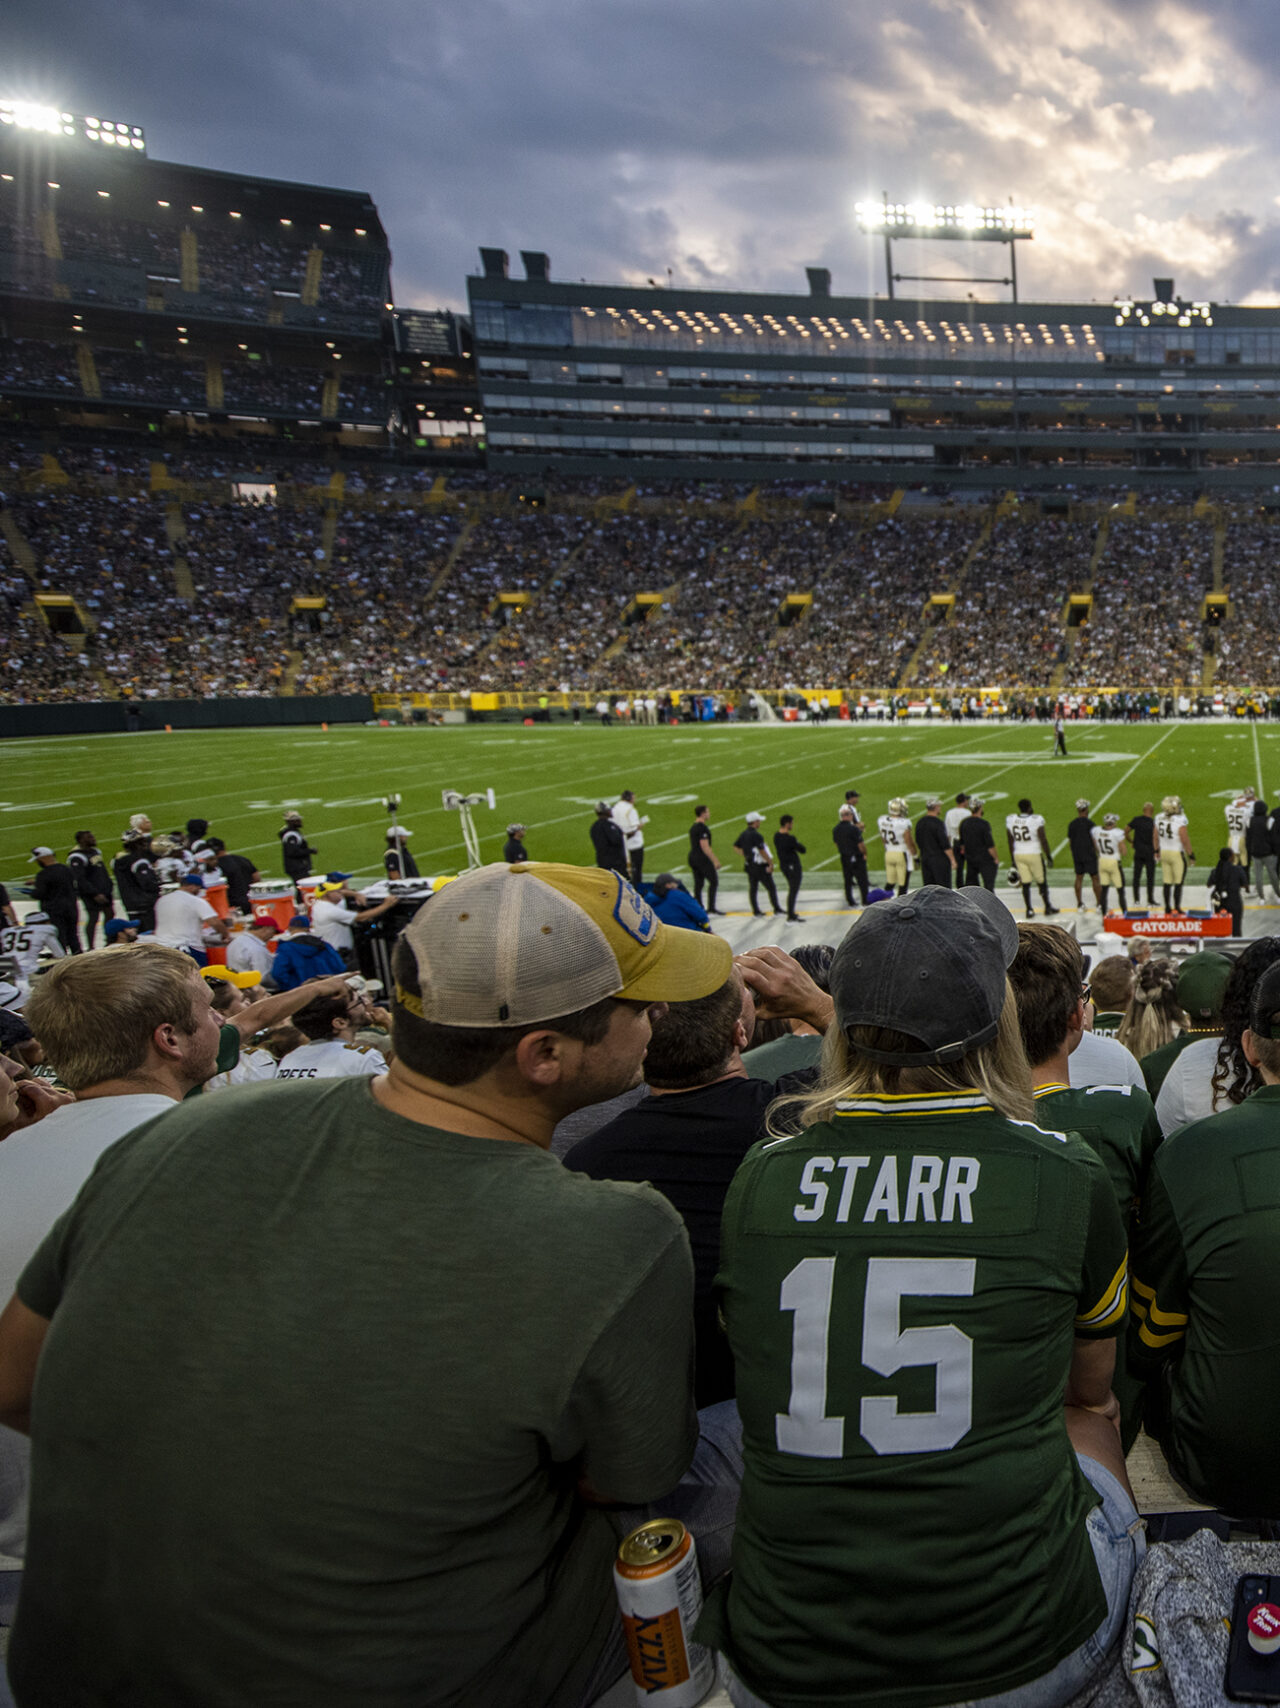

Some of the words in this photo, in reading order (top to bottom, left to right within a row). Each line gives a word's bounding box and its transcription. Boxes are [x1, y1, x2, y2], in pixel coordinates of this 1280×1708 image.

[1012, 826, 1031, 841] 62
[3, 931, 34, 952] 35
[1132, 921, 1203, 933] GATORADE
[793, 1155, 981, 1223] STARR
[775, 1254, 977, 1459] 15
[632, 1608, 669, 1695] VIZZY
